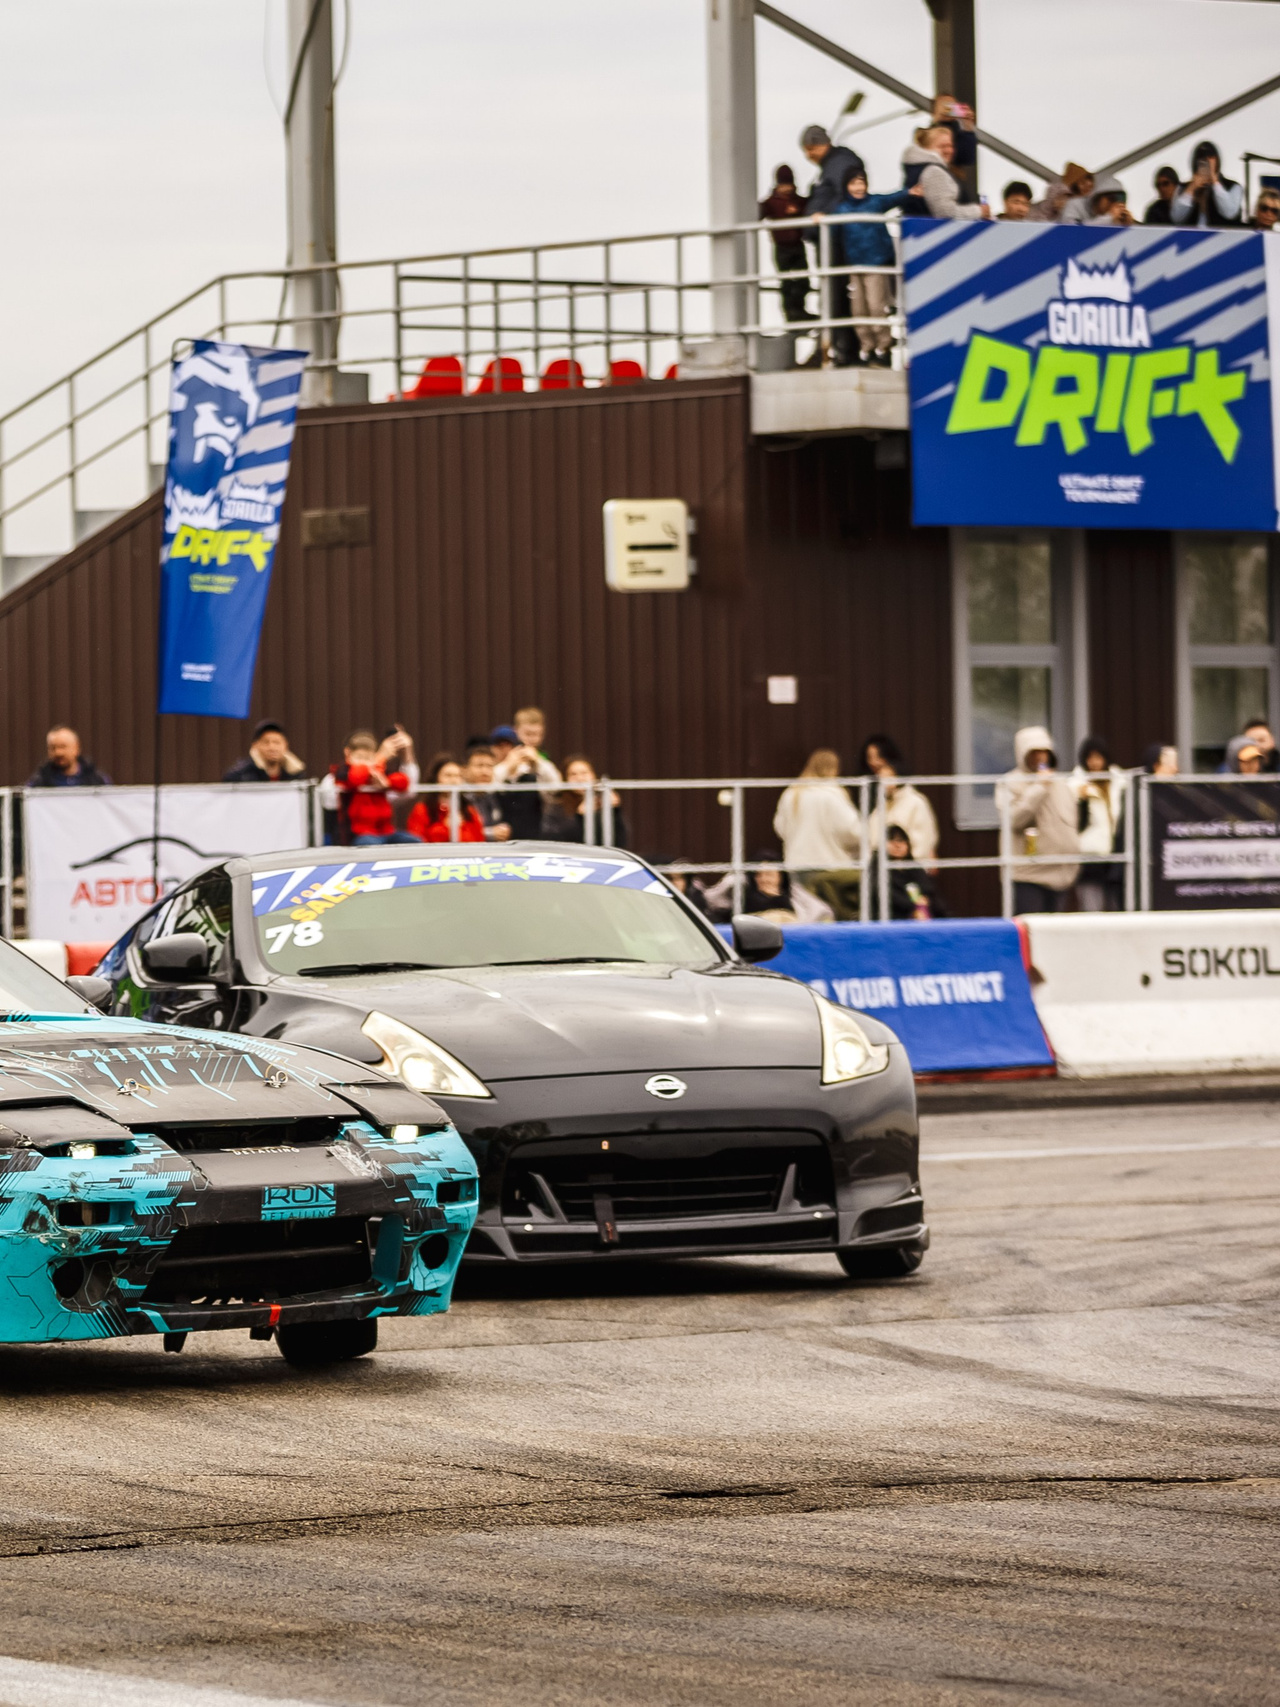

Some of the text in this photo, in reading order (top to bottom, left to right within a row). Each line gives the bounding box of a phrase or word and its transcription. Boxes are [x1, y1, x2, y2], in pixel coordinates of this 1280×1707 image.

[1047, 302, 1151, 348] GORILLA
[290, 879, 359, 923] SALE
[265, 920, 324, 954] 78
[1162, 946, 1280, 978] SOKOL
[832, 976, 898, 1010] YOUR
[899, 970, 1006, 1007] INSTINCT
[261, 1208, 336, 1220] DETAILING
